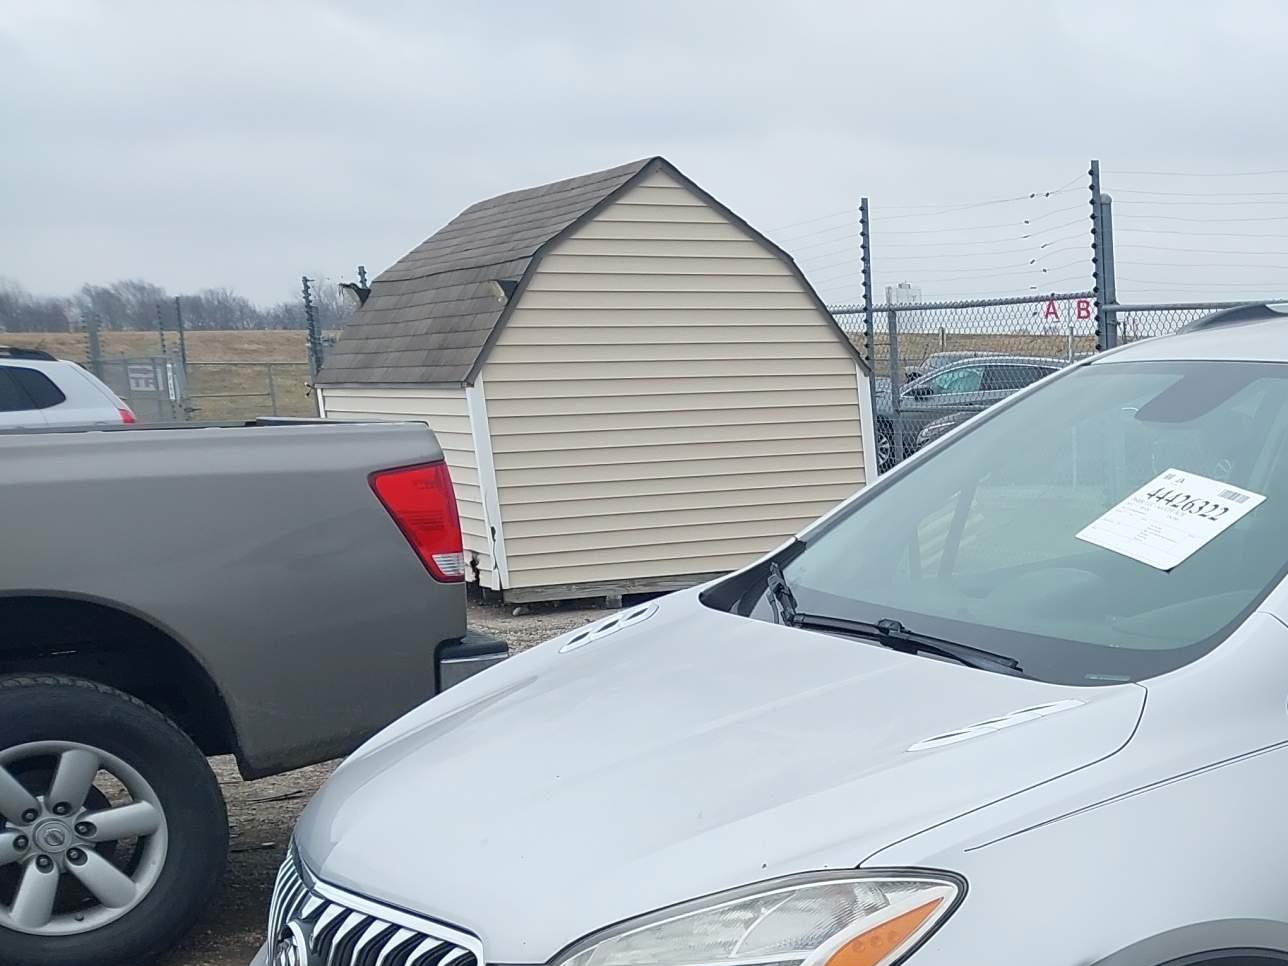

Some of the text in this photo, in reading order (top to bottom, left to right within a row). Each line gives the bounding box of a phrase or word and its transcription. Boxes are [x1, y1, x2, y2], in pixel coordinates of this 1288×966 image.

[1044, 298, 1060, 319] A
[1076, 299, 1091, 319] B
[1146, 487, 1230, 521] 44426322
